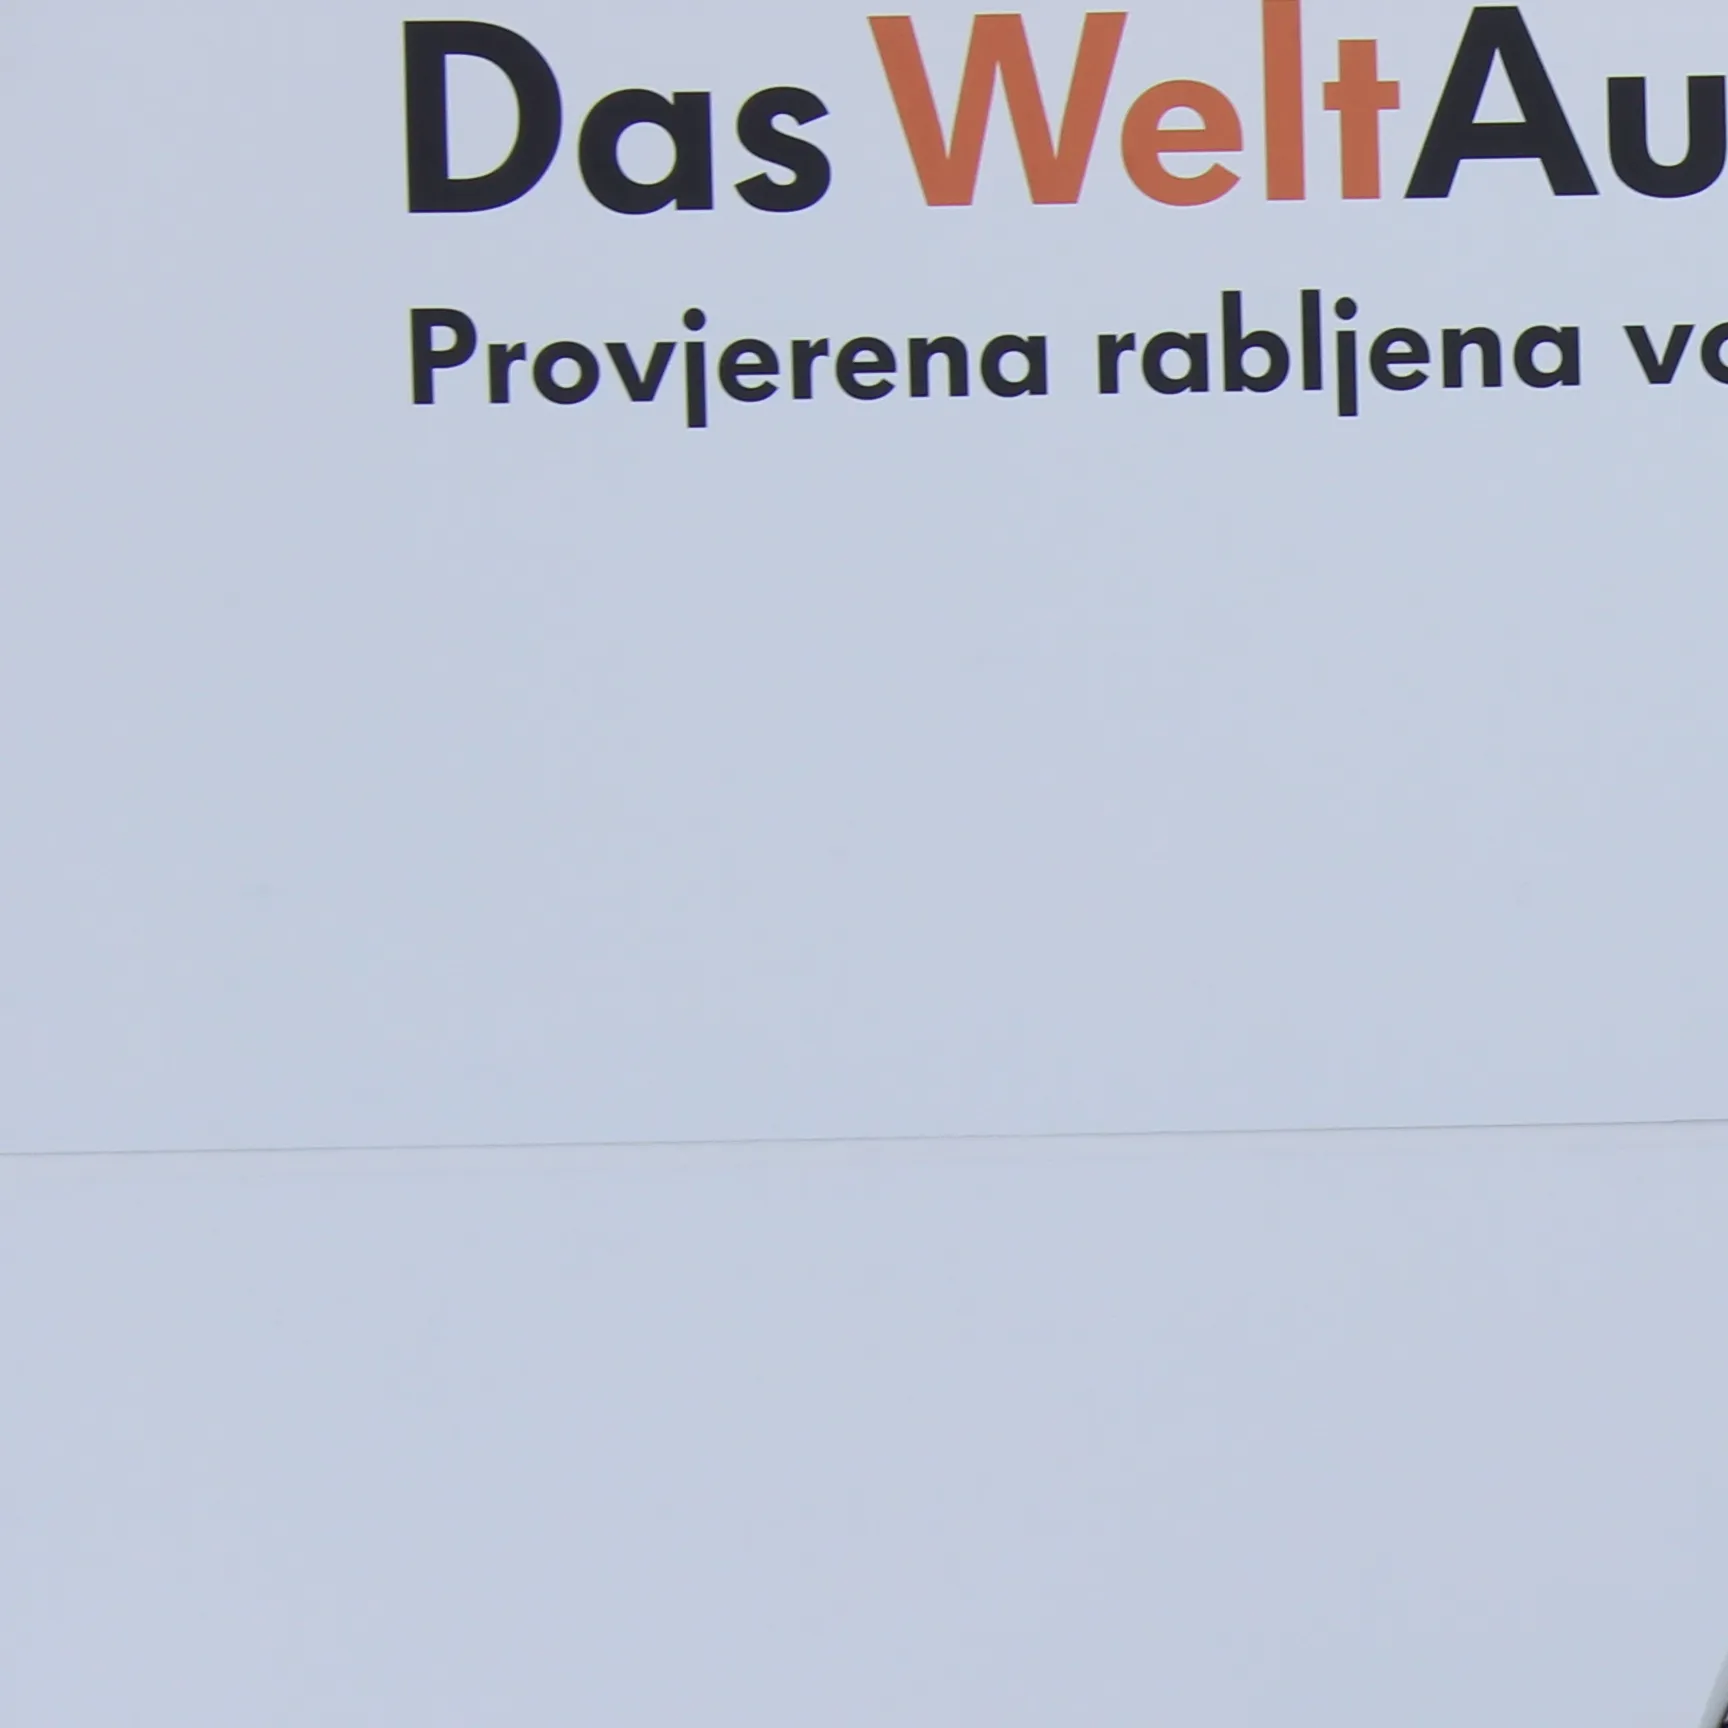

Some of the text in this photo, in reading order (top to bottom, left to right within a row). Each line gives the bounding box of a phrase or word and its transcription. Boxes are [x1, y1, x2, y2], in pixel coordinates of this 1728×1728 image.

[403, 21, 831, 215] Das
[411, 308, 1047, 428] Provjerena
[1098, 289, 1580, 416] rabljena
